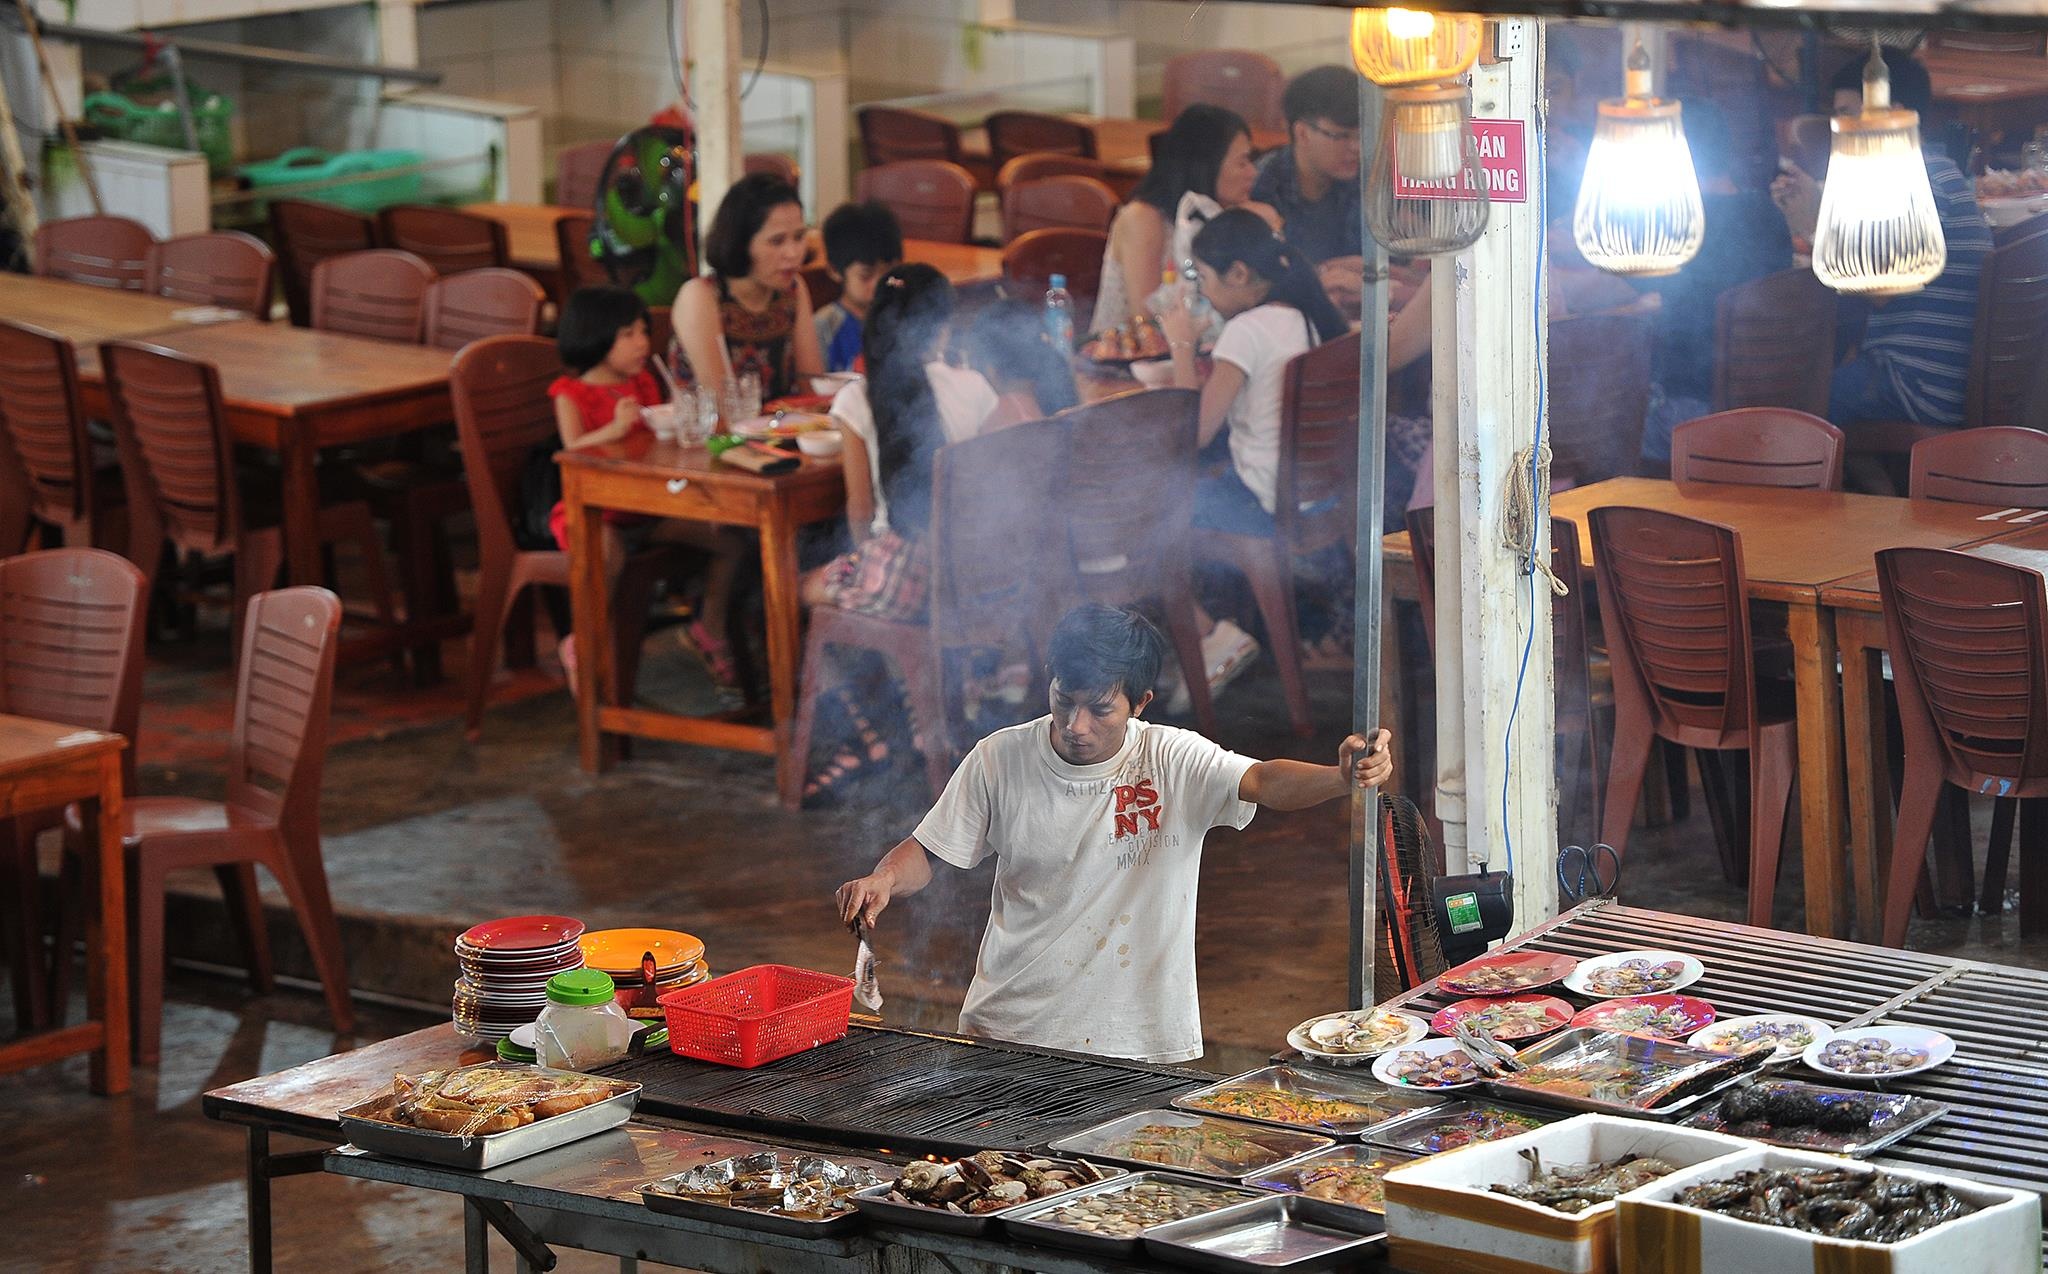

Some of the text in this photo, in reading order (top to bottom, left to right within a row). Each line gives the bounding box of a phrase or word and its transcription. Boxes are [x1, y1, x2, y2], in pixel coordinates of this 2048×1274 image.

[1114, 778, 1160, 813] PS
[1114, 805, 1163, 839] NY
[1128, 834, 1180, 853] DIVISION
[1116, 848, 1151, 871] MMIX
